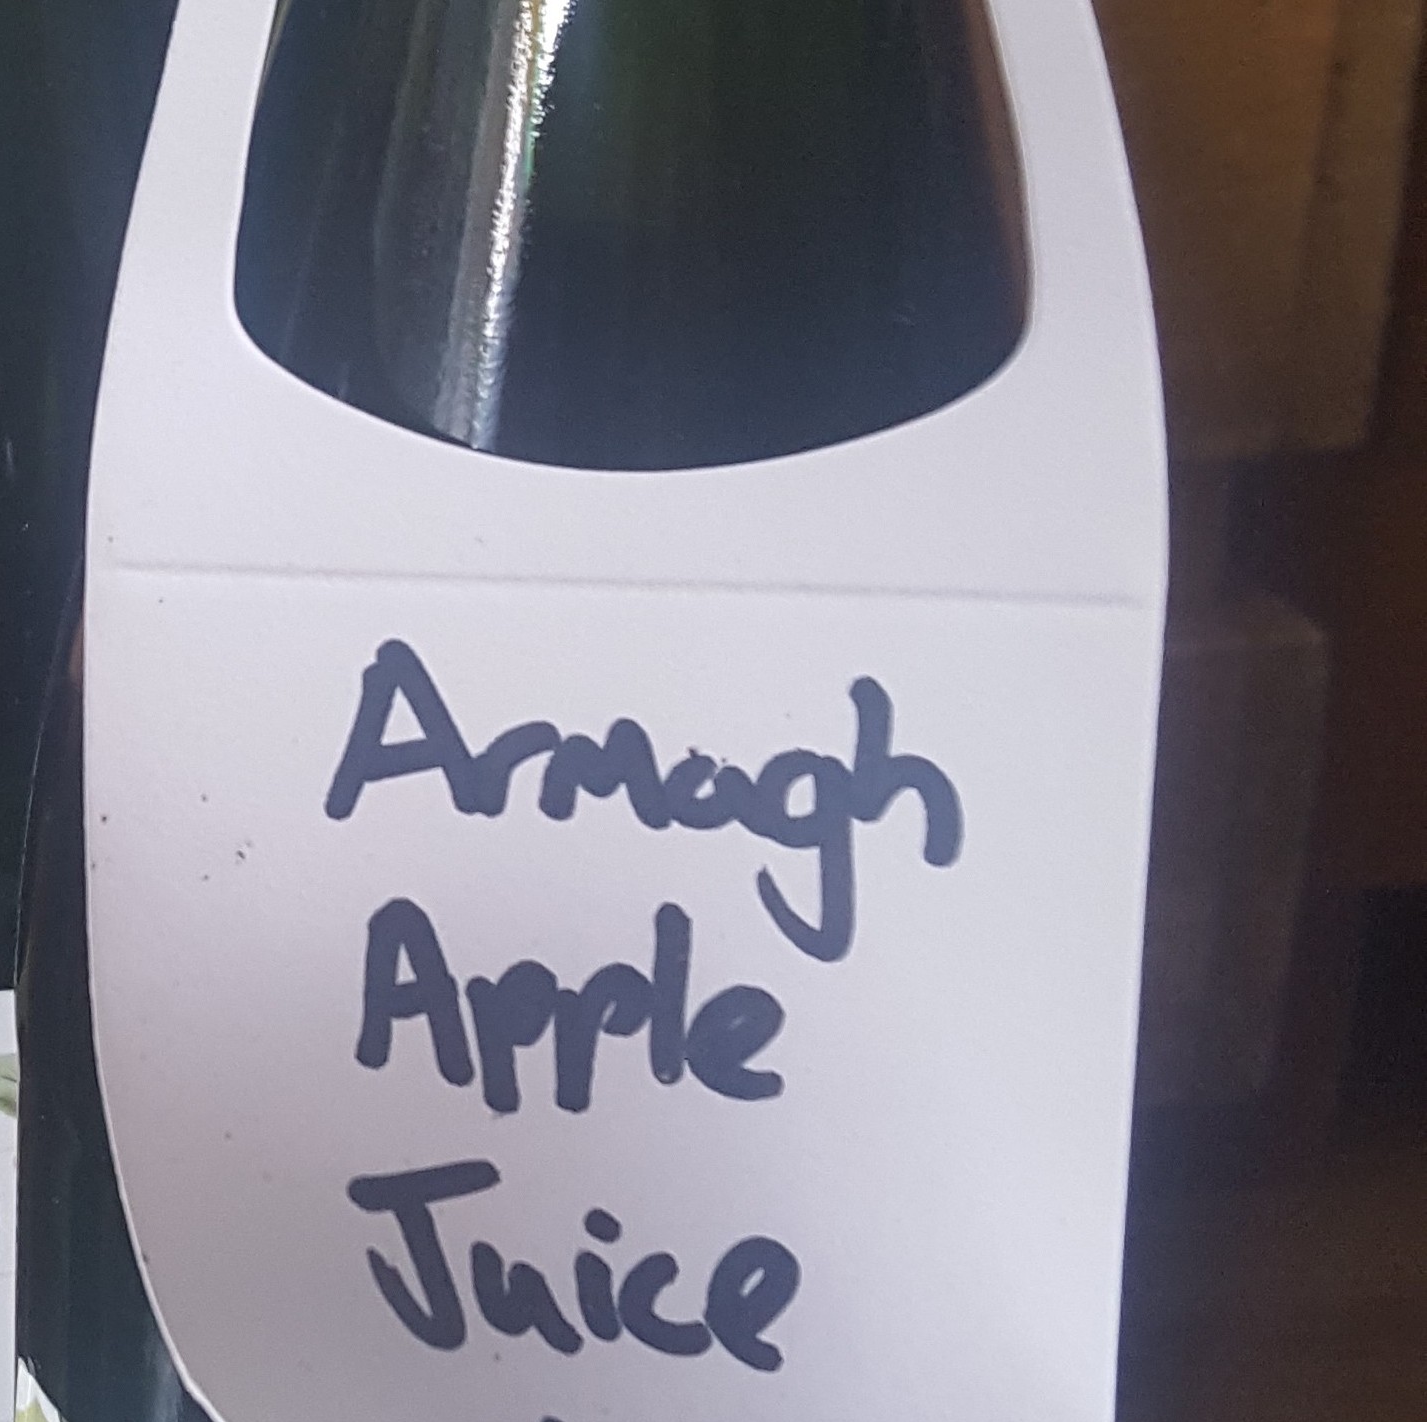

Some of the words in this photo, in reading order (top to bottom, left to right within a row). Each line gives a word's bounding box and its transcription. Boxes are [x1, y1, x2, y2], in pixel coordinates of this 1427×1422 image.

[324, 638, 965, 962] Armagh
[355, 898, 786, 1114] Apple
[346, 1159, 802, 1373] Juice
